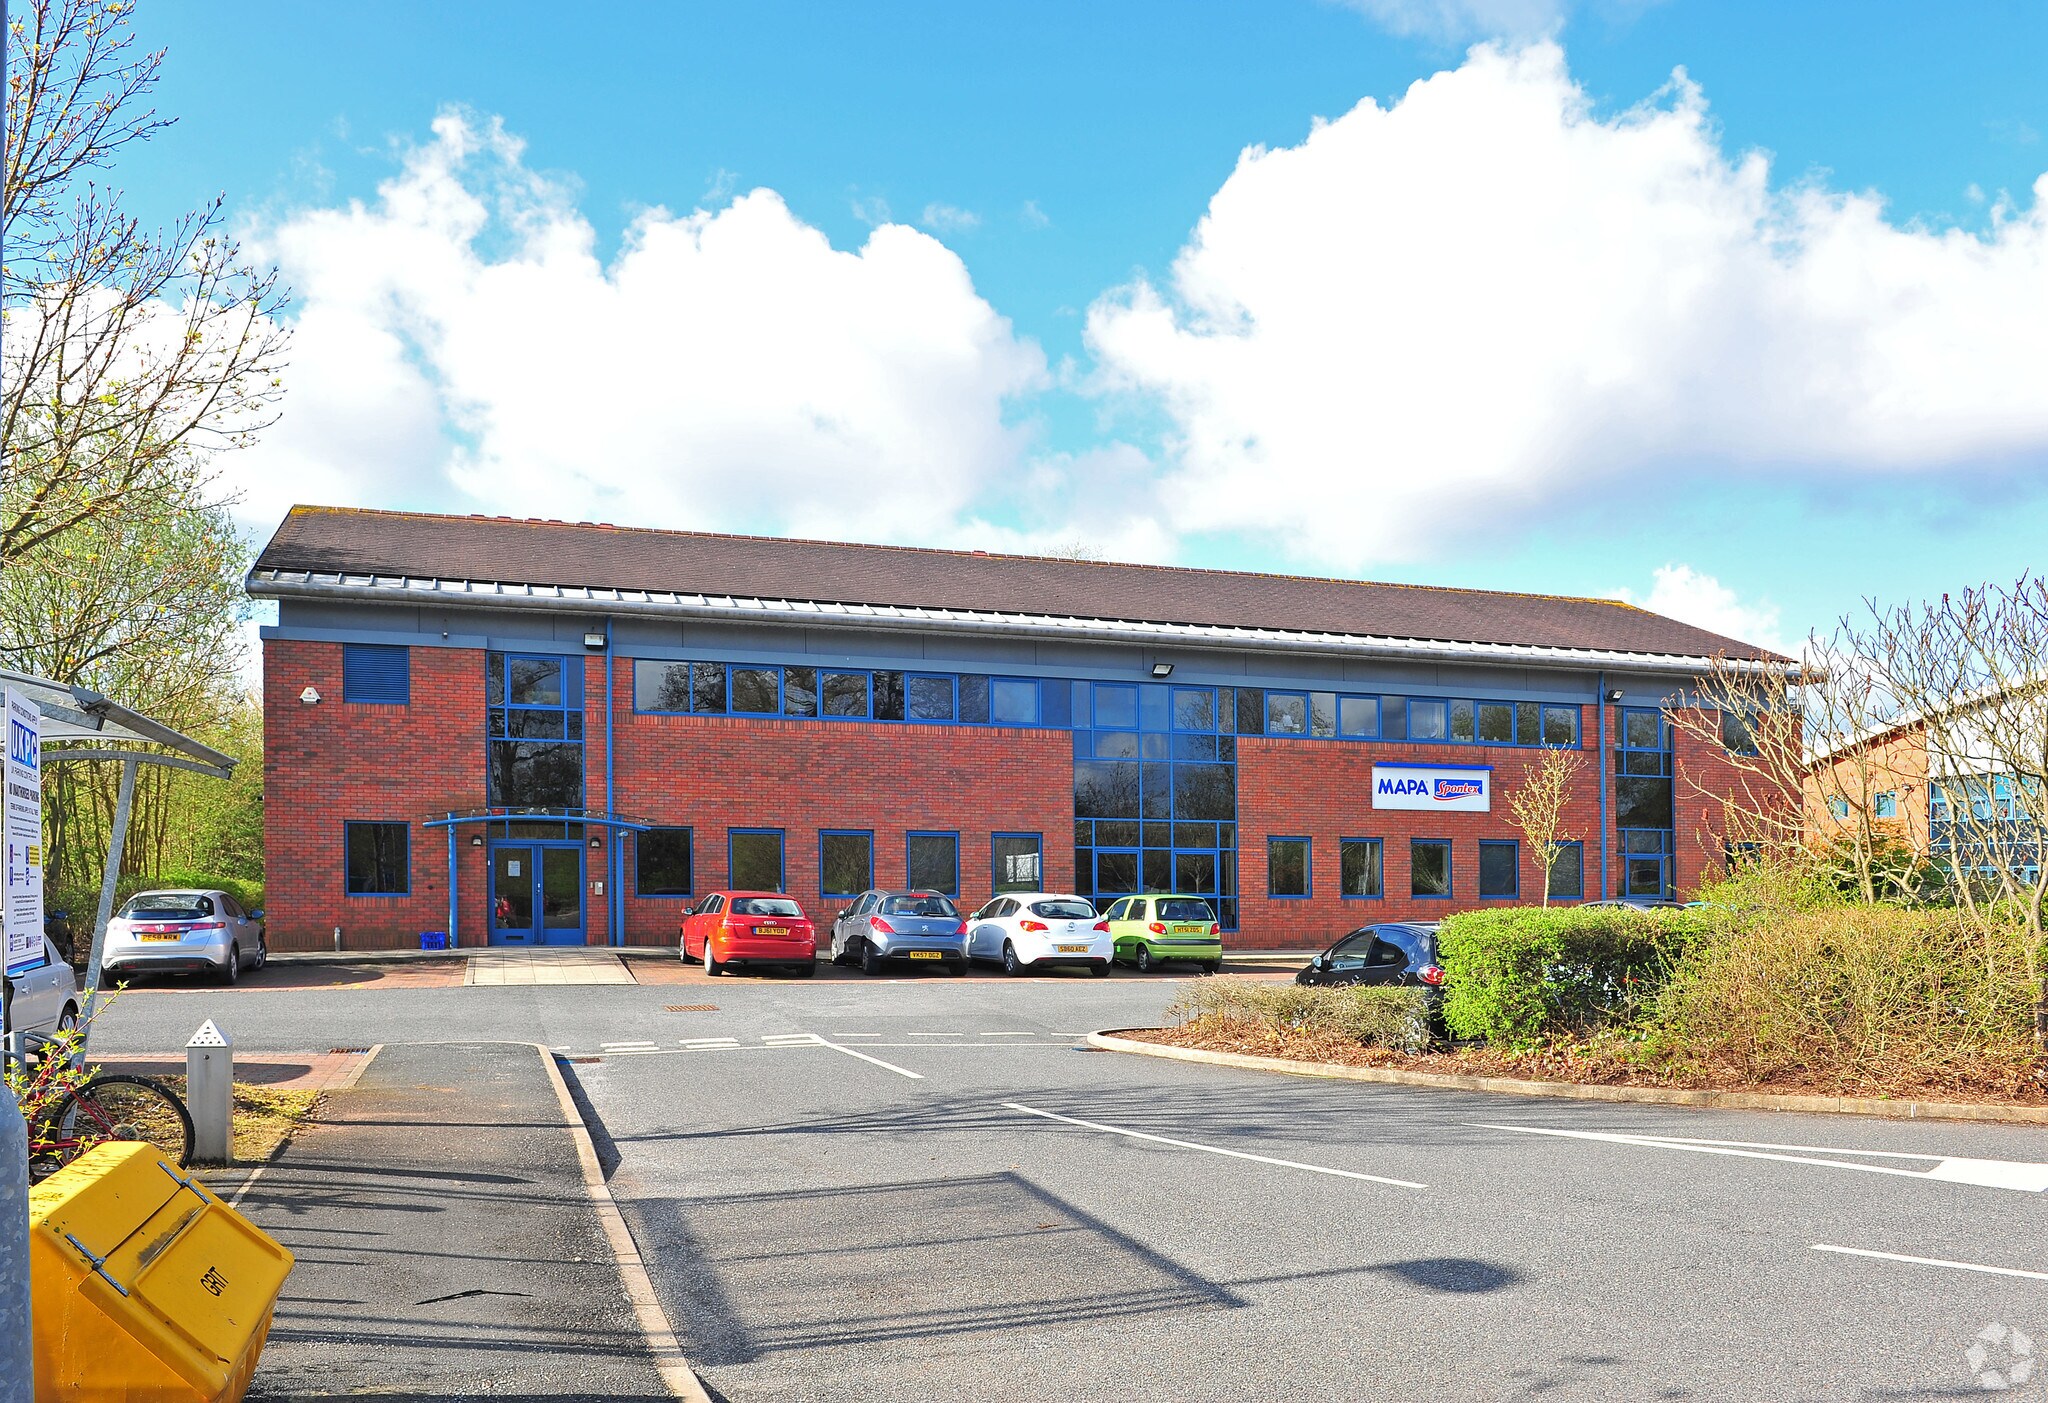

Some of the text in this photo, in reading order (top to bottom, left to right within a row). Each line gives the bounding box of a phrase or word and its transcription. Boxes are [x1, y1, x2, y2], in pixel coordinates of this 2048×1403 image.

[12, 722, 37, 767] UKPC
[1378, 779, 1478, 796] MAPA Spontex
[200, 1266, 229, 1297] GRIT
